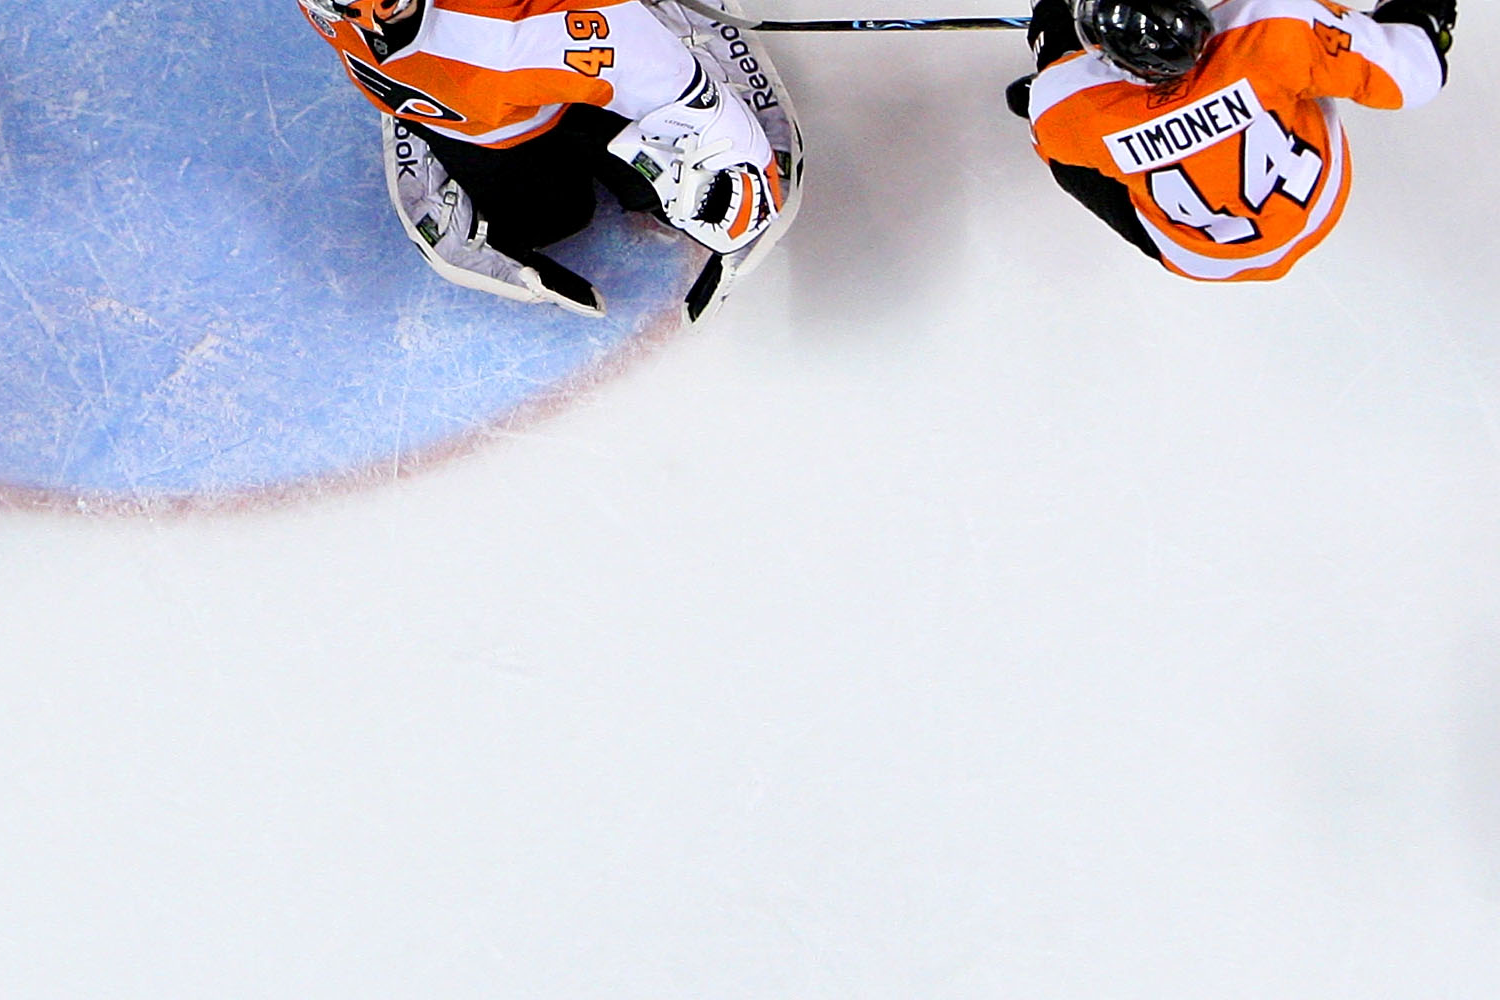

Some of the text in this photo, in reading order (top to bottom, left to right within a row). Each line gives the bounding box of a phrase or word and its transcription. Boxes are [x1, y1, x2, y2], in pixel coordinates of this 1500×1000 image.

[563, 10, 615, 77] 49
[711, 21, 779, 112] Reebo
[1117, 89, 1253, 166] TIMONEN
[1145, 109, 1323, 244] 44
